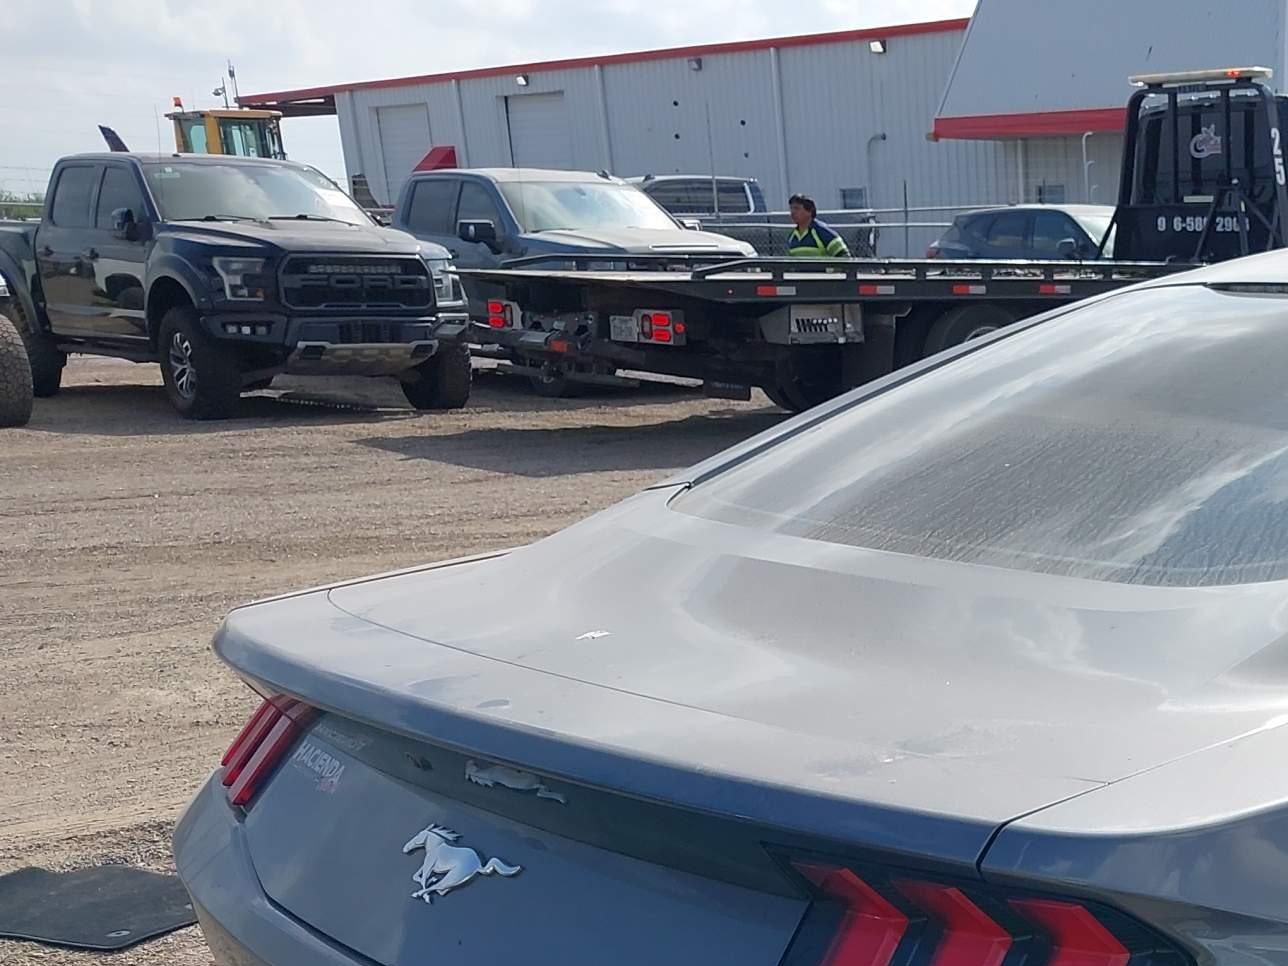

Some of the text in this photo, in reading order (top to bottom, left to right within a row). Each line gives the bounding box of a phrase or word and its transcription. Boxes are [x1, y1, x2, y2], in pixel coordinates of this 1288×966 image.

[1270, 127, 1286, 185] 25
[285, 274, 428, 289] FORD
[293, 740, 345, 782] HACIENDA
